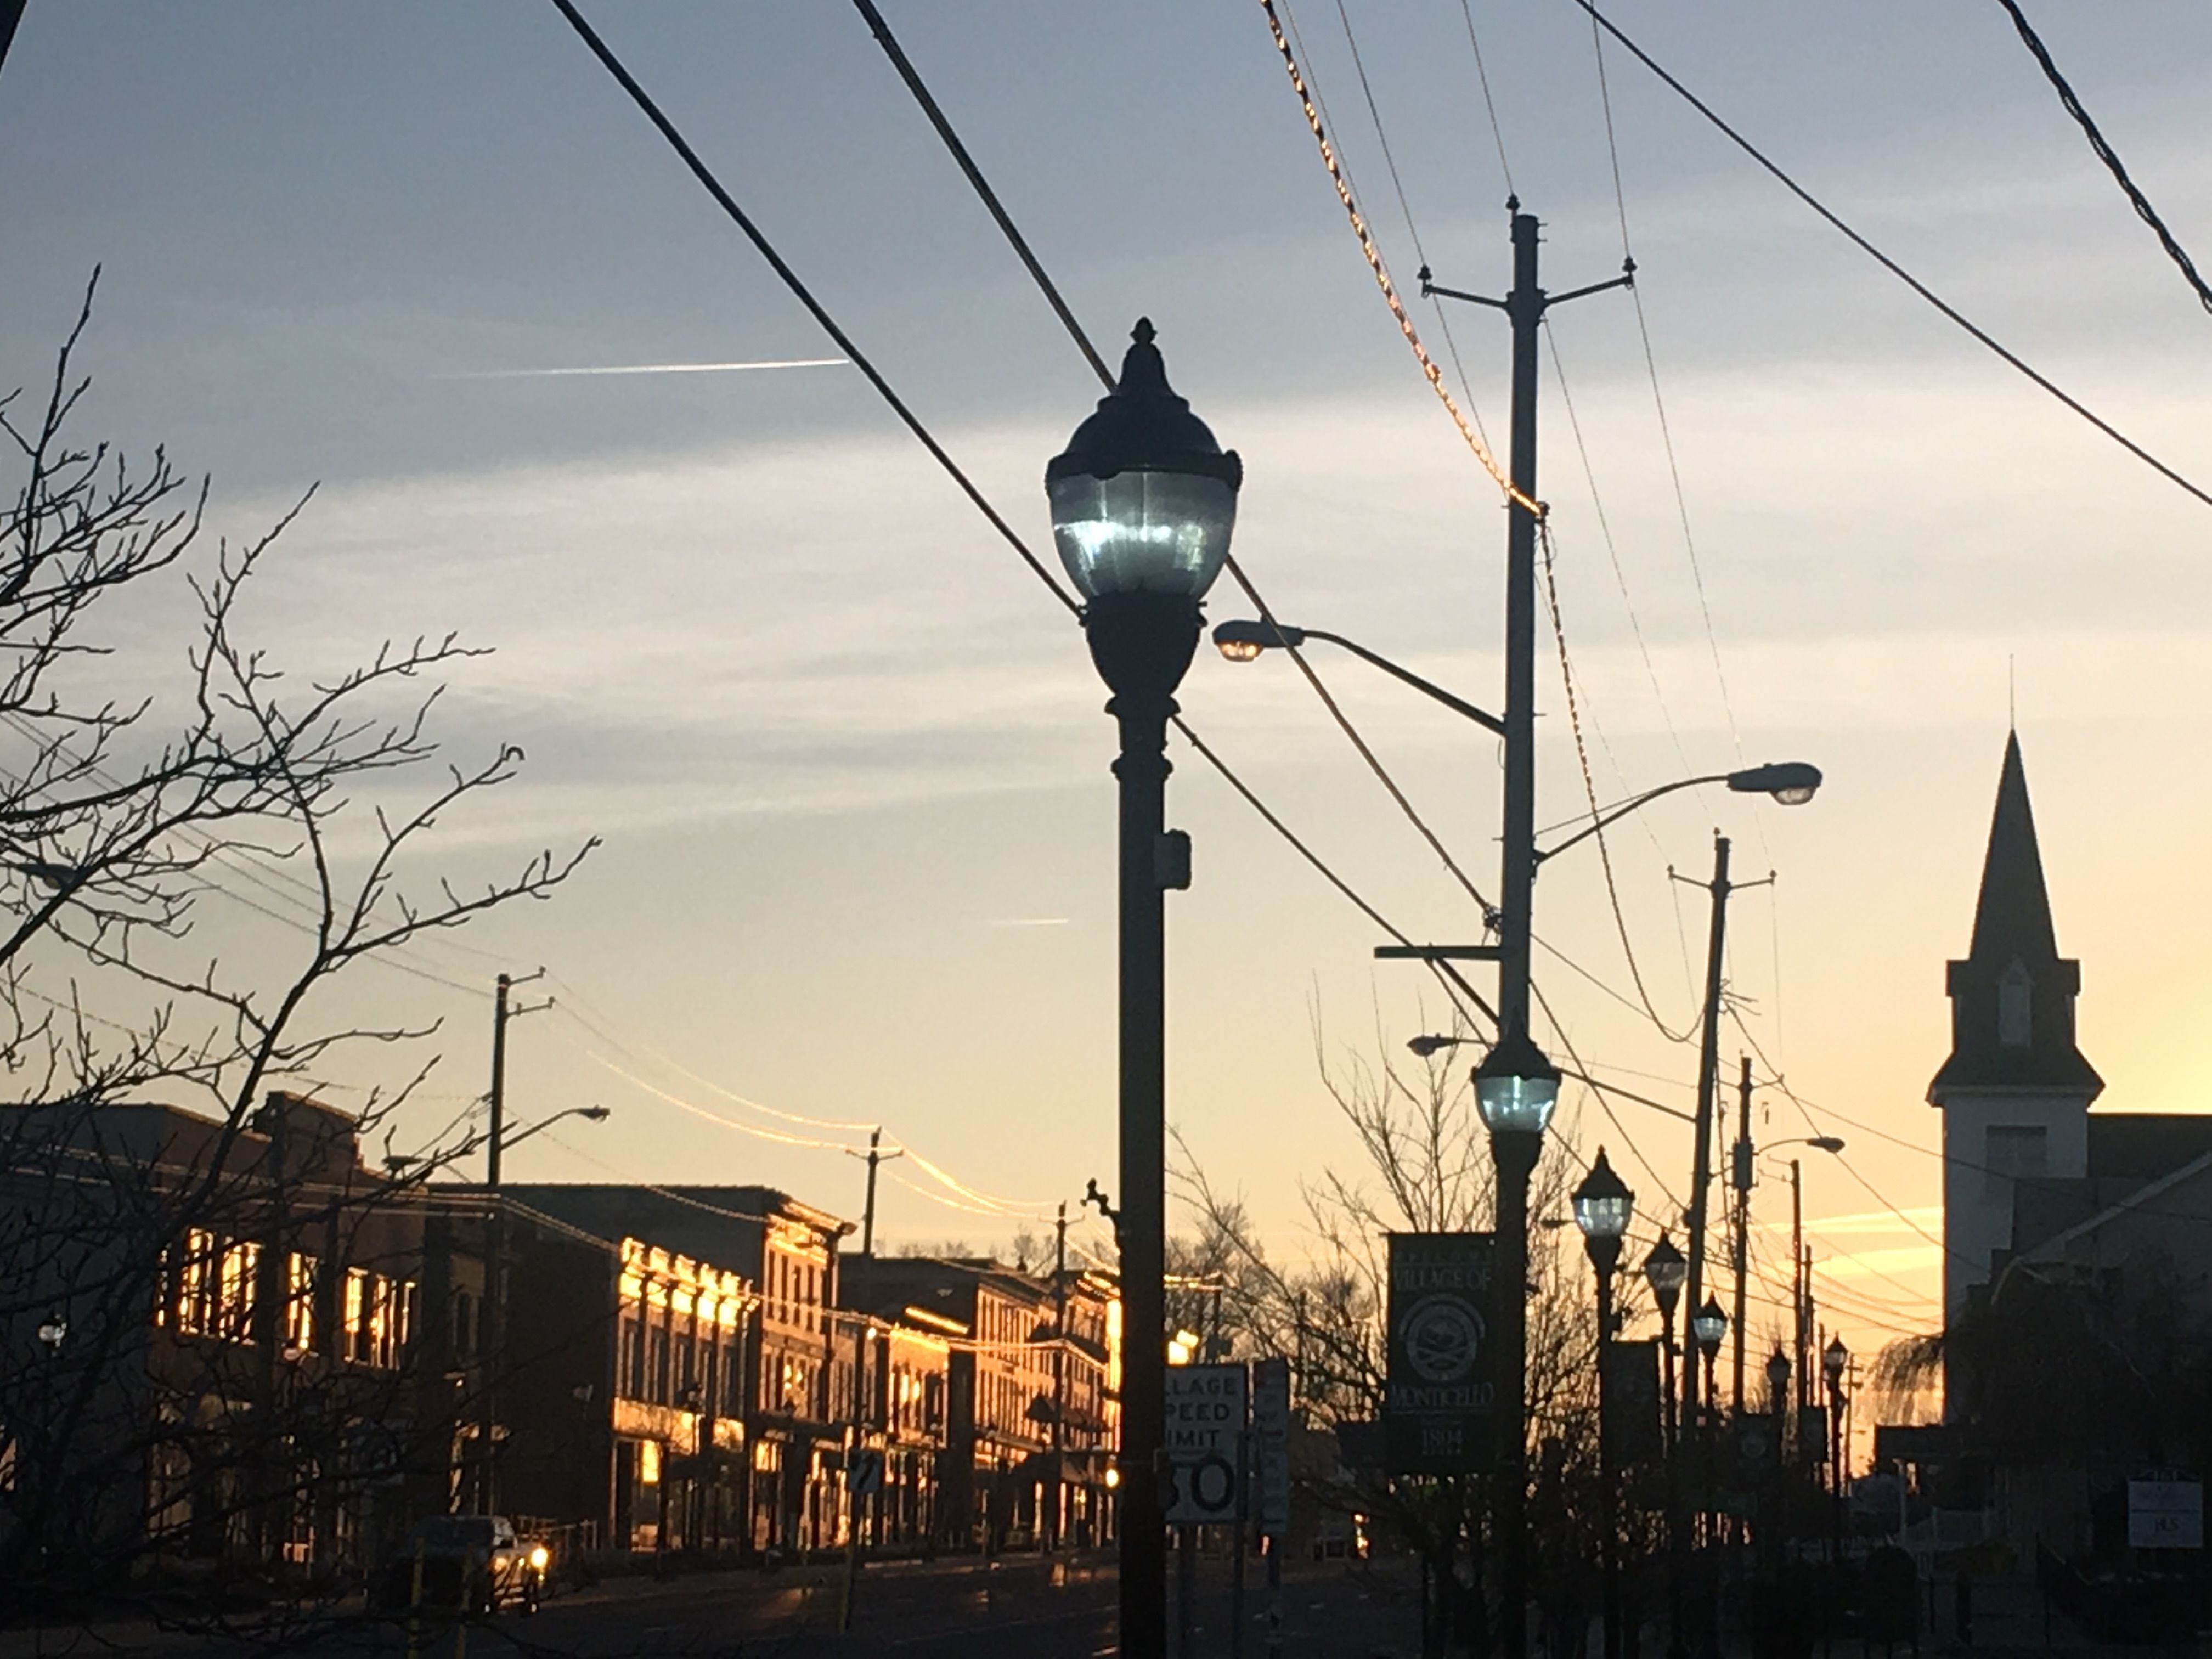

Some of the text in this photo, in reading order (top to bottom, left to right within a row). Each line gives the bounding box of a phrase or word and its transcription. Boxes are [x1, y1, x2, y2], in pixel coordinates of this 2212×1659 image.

[1394, 1267, 1464, 1291] VILLAGE
[1165, 1377, 1237, 1396] LAGE
[1165, 1402, 1229, 1421] PEED
[1167, 1429, 1220, 1447] IMIT
